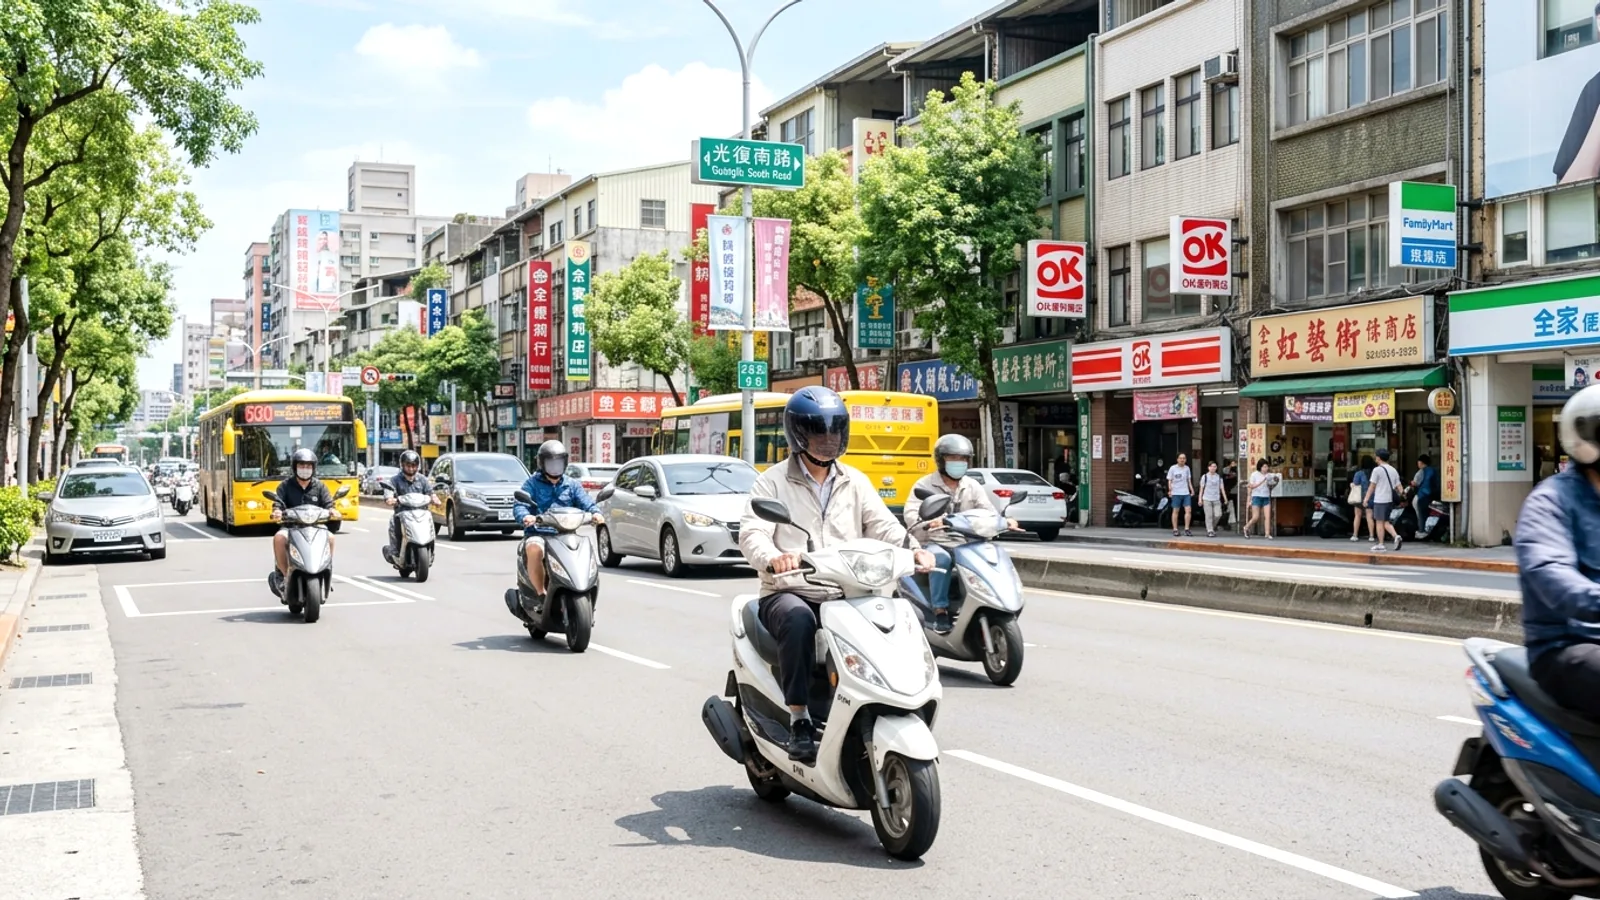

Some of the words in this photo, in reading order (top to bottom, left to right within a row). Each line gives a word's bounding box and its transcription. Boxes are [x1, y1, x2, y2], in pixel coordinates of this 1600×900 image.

[1183, 231, 1227, 263] OK
[1037, 256, 1083, 287] OK
[1133, 348, 1151, 369] OK
